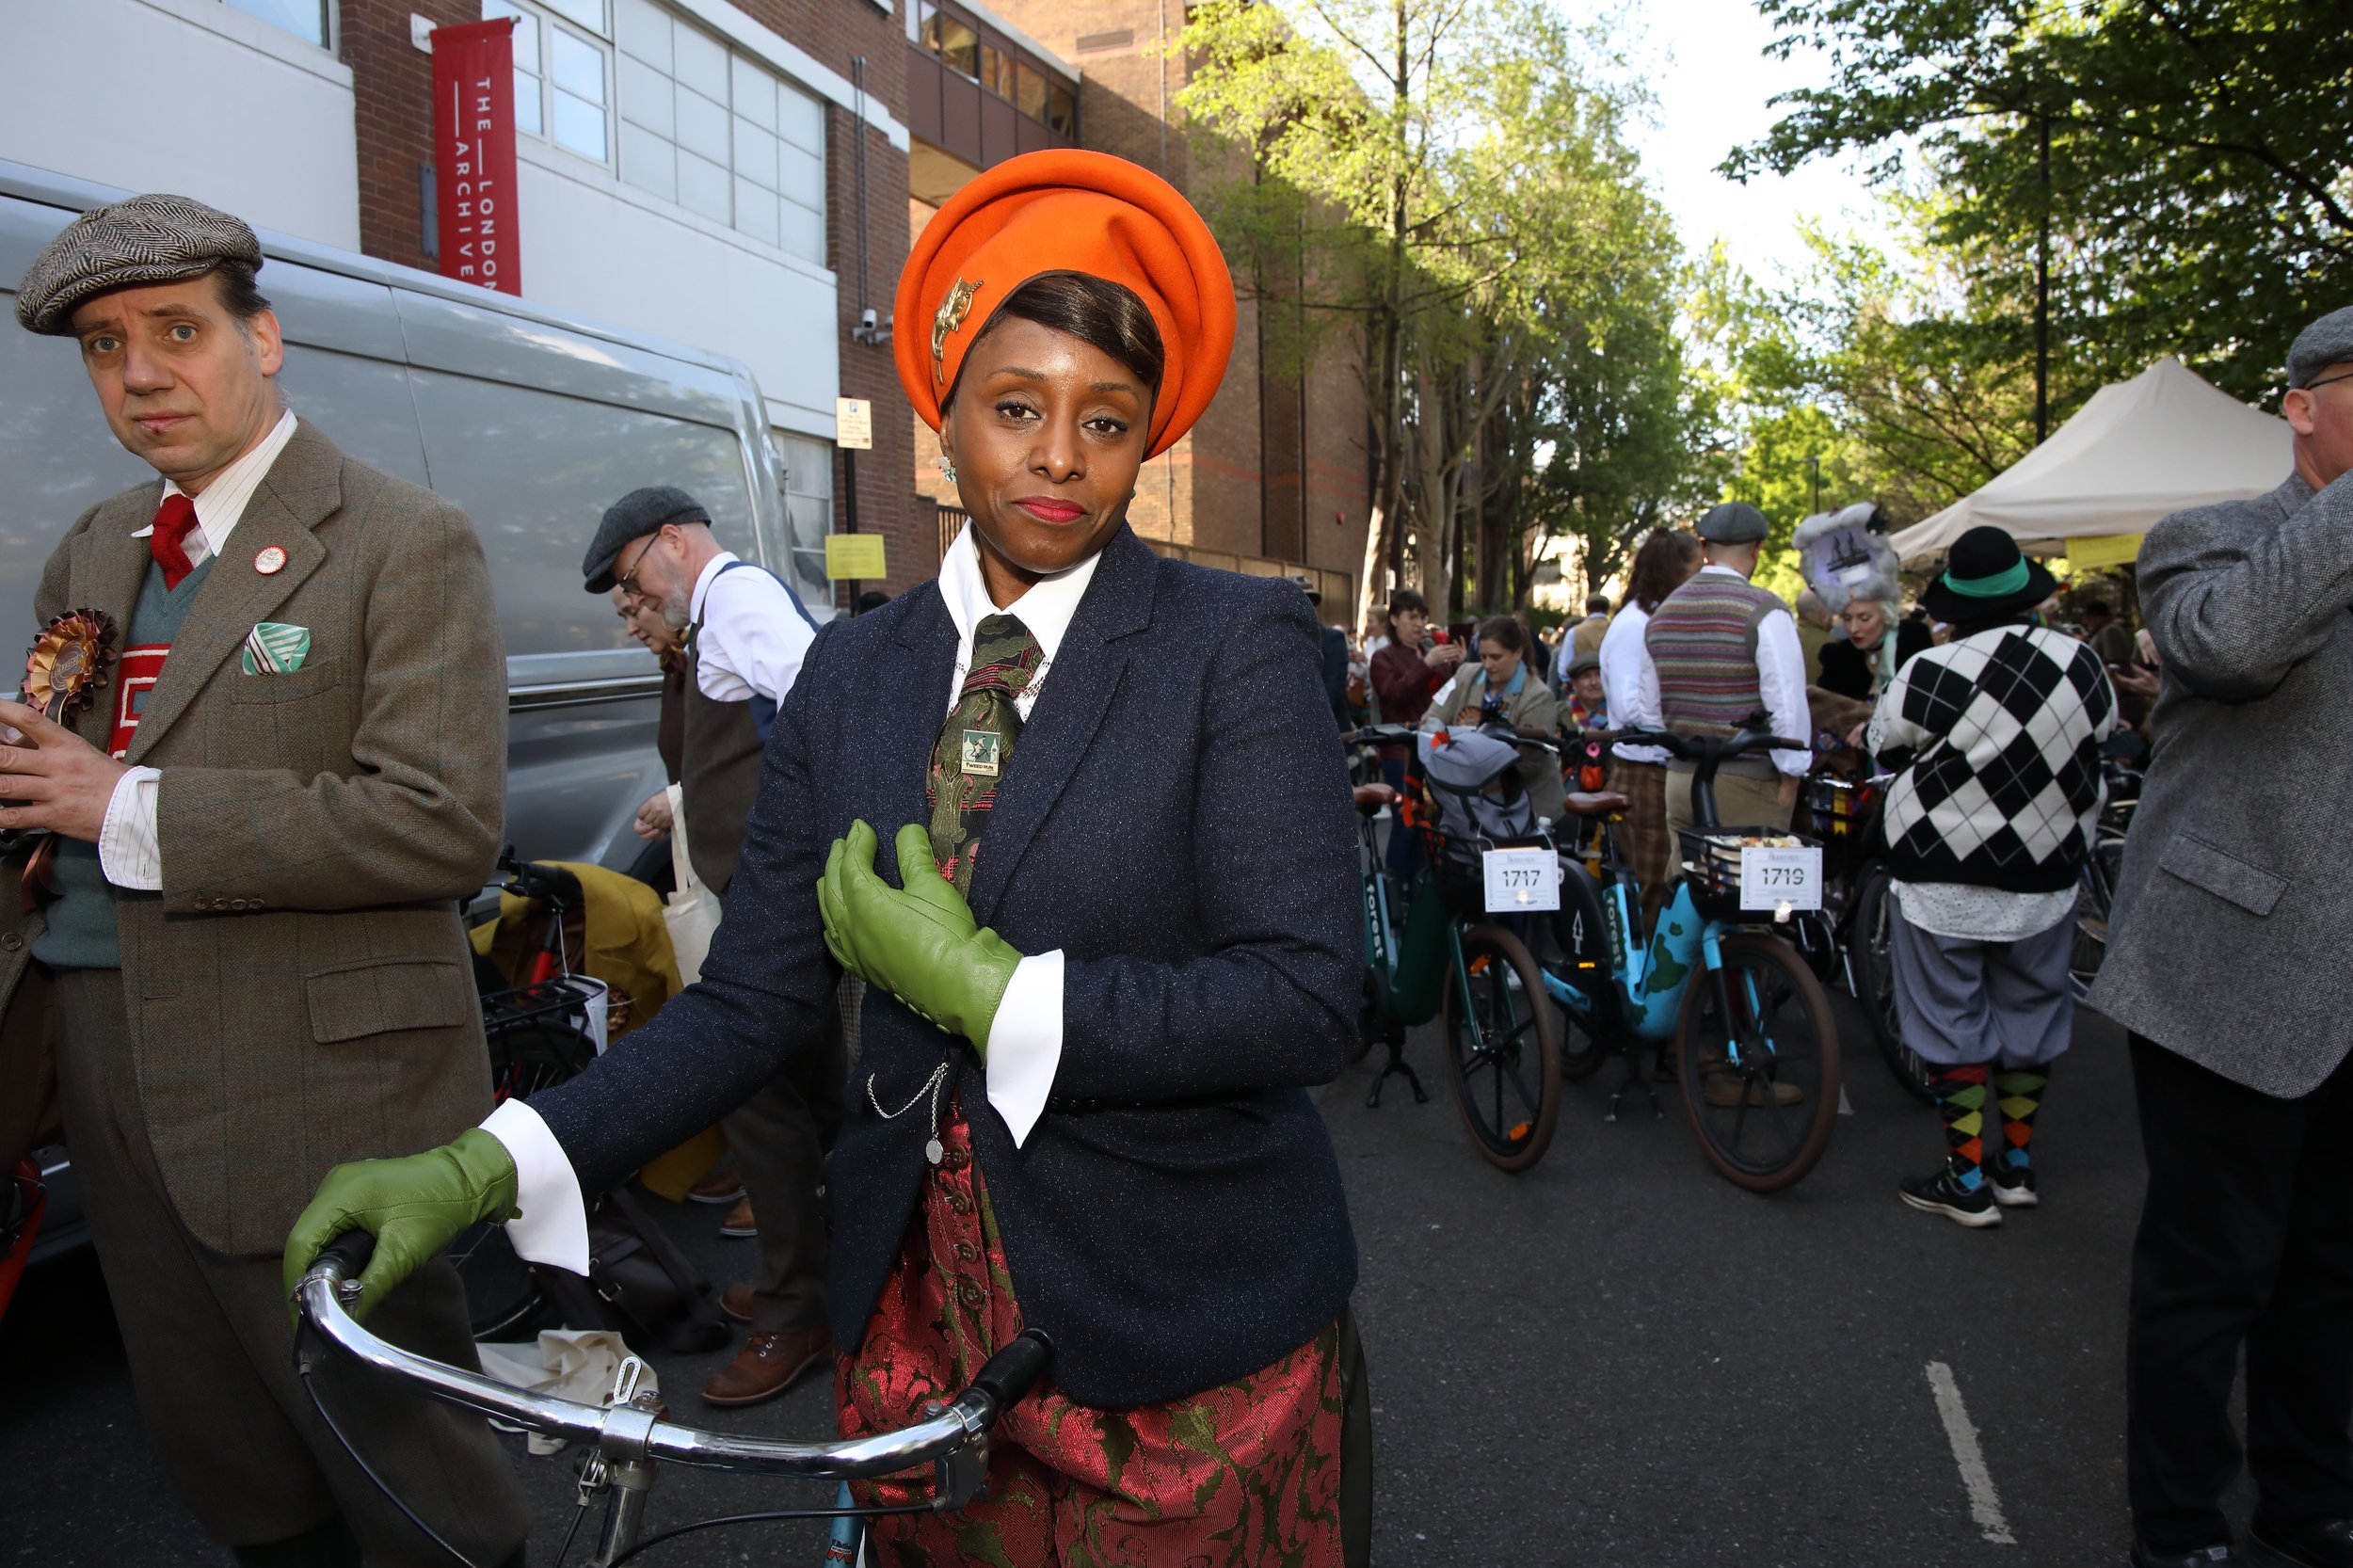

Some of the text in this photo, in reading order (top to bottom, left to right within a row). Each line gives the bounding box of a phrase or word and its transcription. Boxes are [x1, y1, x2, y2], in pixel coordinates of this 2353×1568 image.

[476, 76, 491, 132] THE
[456, 141, 474, 278] ARCHIVE
[1502, 870, 1541, 888] 1717
[1762, 868, 1804, 886] 1719
[1367, 884, 1384, 958] forest
[1607, 895, 1622, 965] forest
